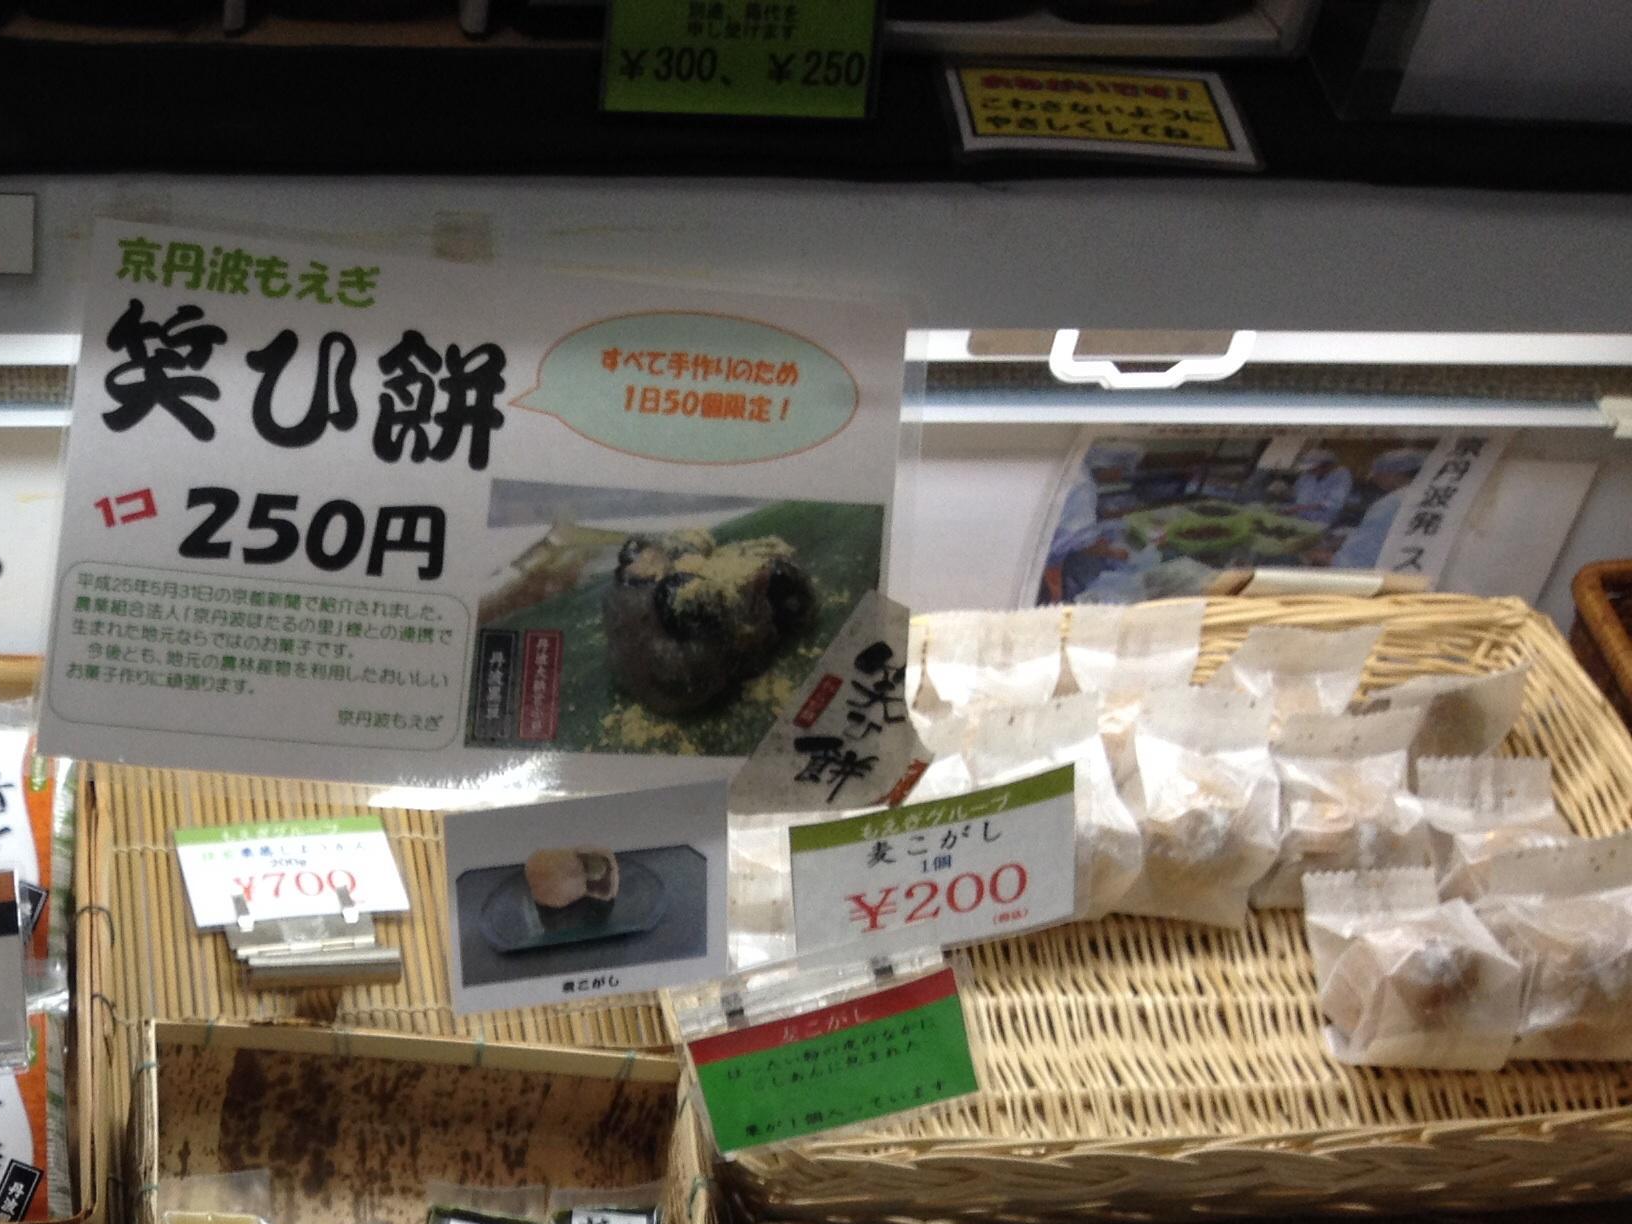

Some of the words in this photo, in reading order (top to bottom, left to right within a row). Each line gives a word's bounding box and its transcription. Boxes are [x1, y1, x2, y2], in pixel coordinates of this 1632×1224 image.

[114, 236, 381, 309] 京丹波もえぎ
[100, 299, 509, 471] 笑ひ餅
[600, 347, 800, 387] すべて手作りのため
[177, 486, 447, 582] 250円
[867, 820, 1002, 868] 麦こがし
